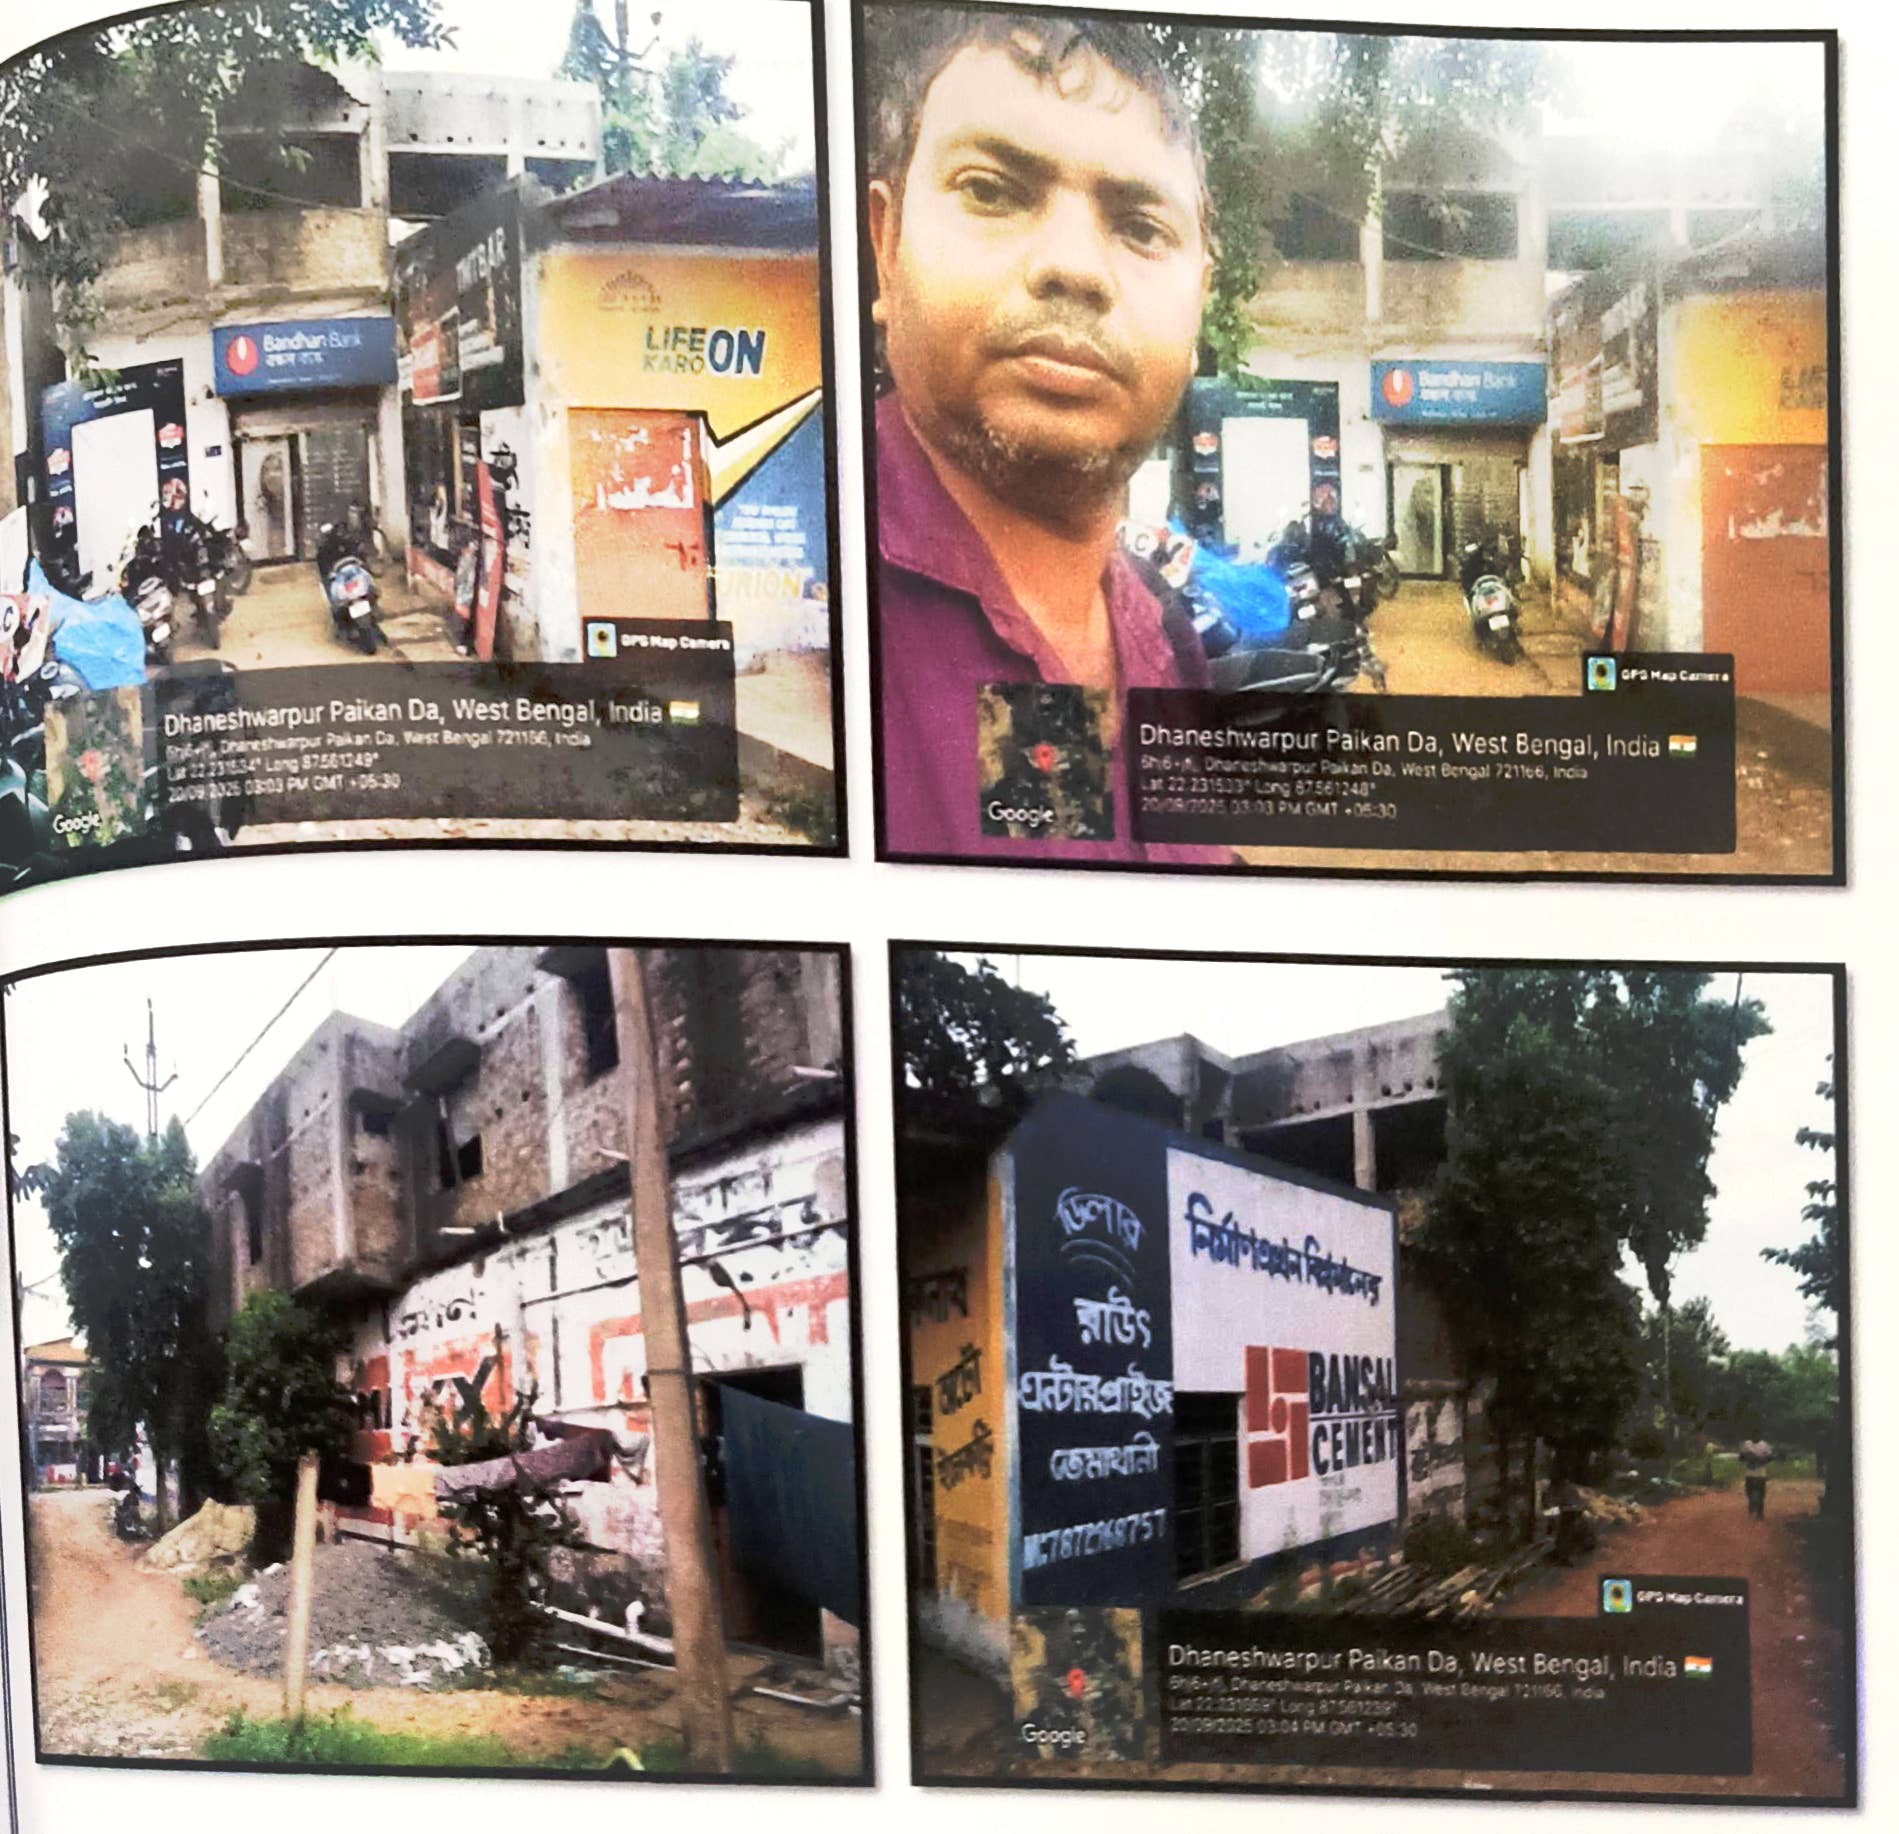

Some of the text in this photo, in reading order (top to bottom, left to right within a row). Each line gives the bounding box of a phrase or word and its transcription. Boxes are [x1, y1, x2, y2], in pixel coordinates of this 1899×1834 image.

[646, 326, 706, 352] LIFE
[709, 329, 765, 375] ON
[643, 354, 705, 374] KARO
[1309, 1351, 1398, 1415] BANSAL
[1312, 1418, 1398, 1476] CEMENT
